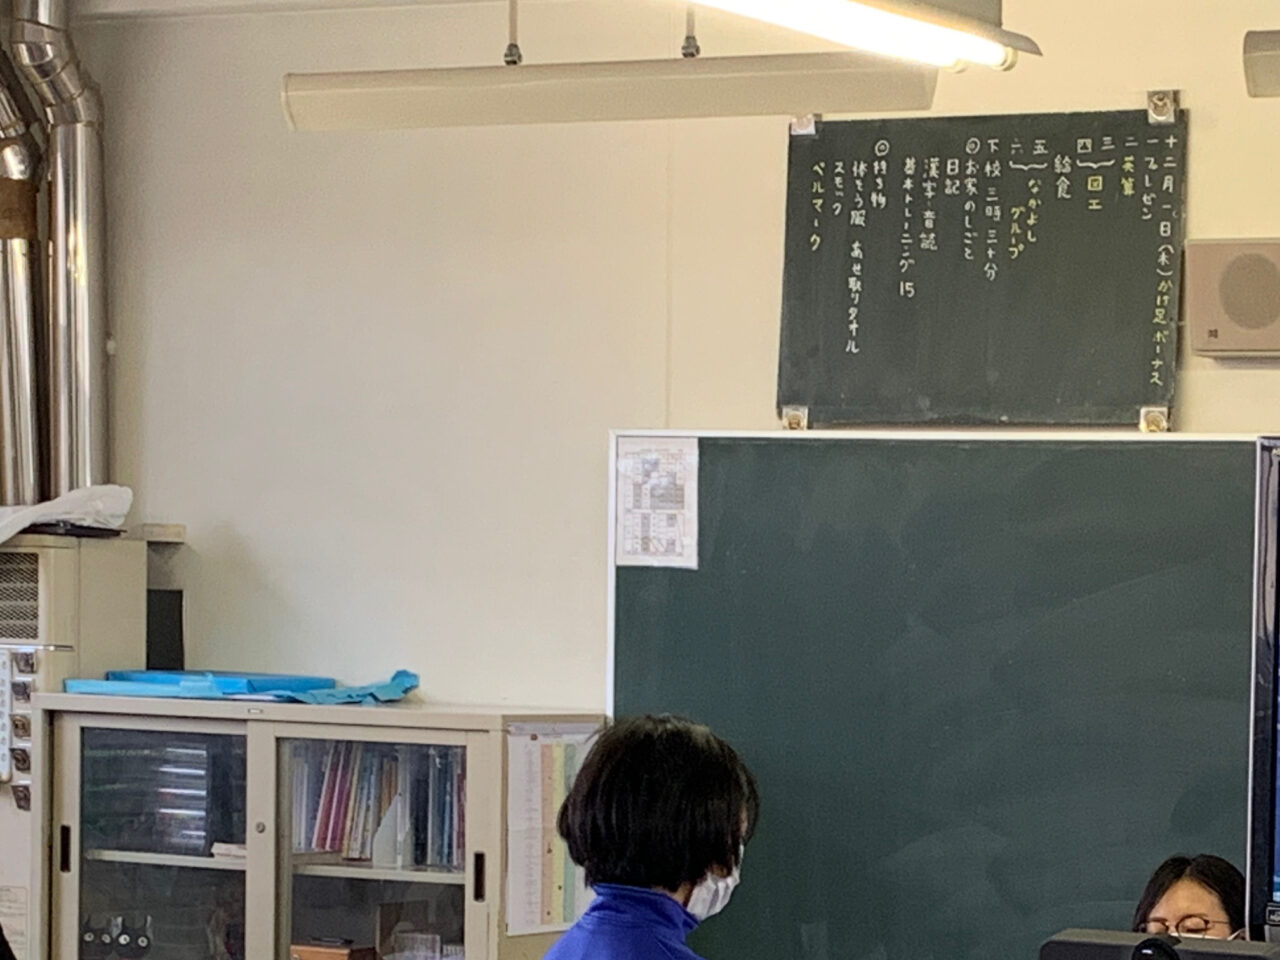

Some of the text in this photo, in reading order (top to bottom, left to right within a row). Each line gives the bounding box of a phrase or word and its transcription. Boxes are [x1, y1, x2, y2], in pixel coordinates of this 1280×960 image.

[1033, 139, 1048, 154] 五
[945, 158, 961, 195] 日記
[1054, 153, 1071, 199] 給食
